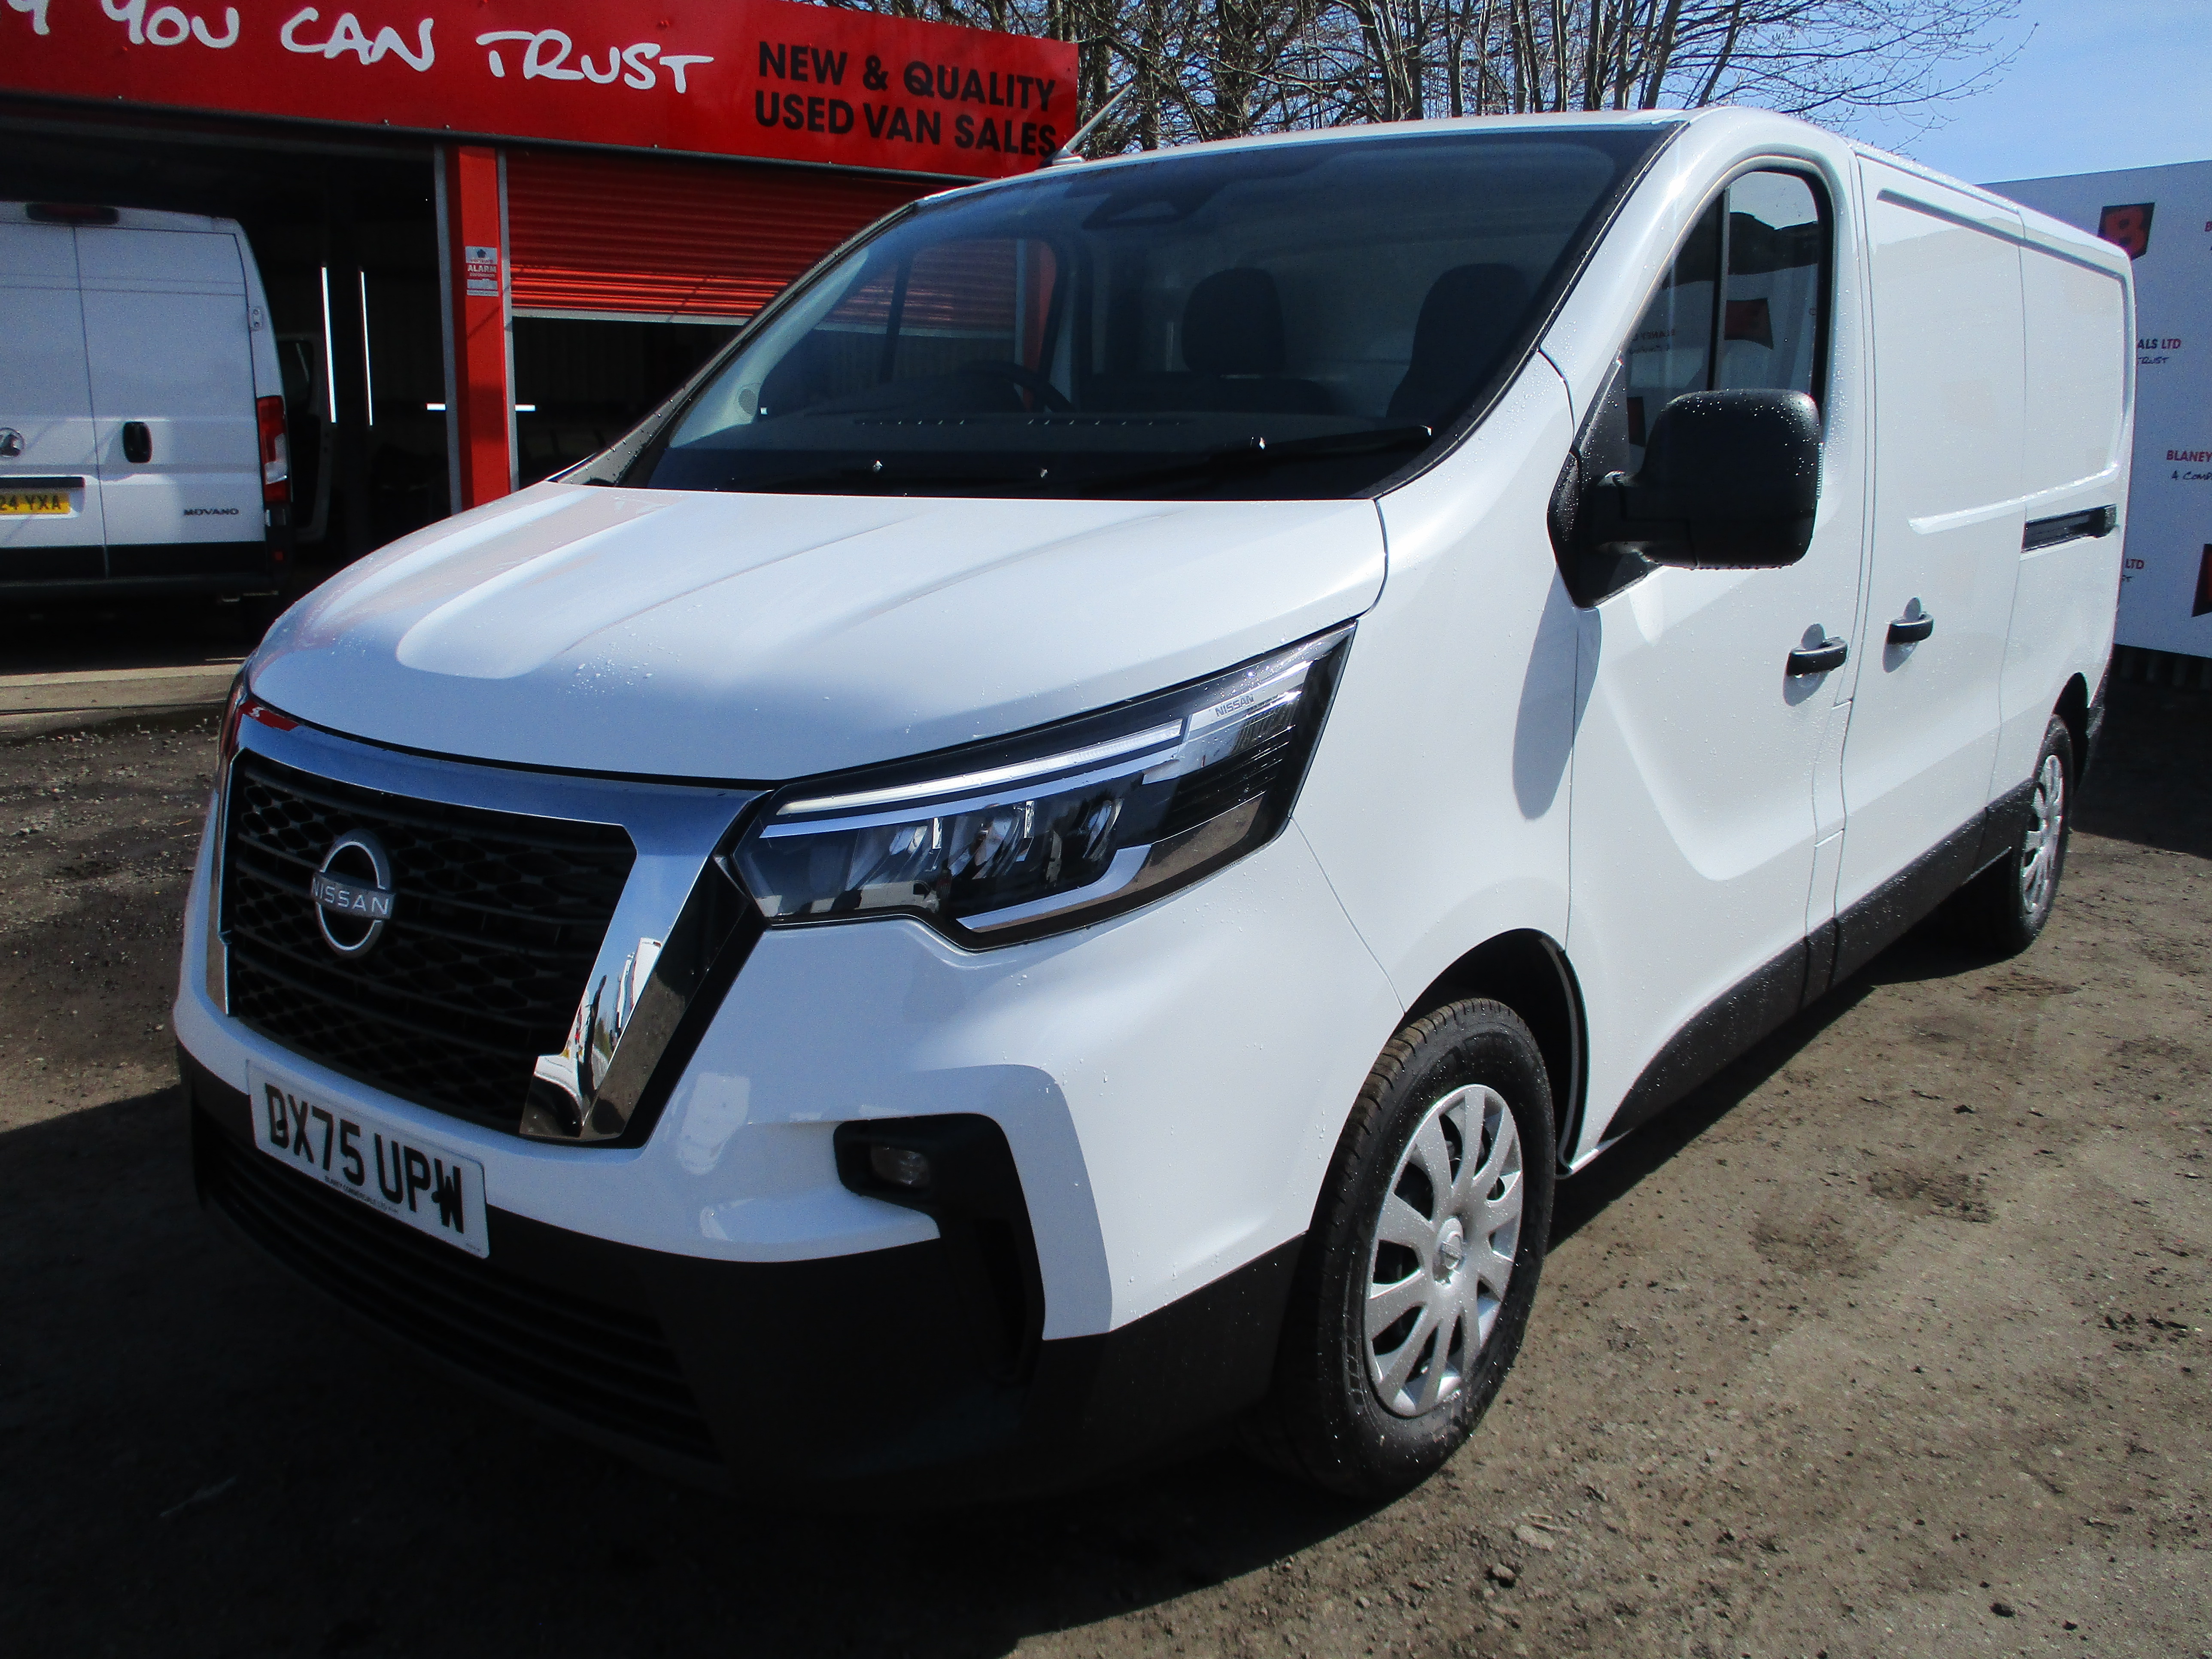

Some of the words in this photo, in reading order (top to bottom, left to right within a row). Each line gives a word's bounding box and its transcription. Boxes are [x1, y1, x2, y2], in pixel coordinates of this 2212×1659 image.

[101, 0, 239, 49] YOU
[280, 6, 434, 72] CAN
[475, 29, 714, 94] TRUST
[759, 41, 848, 86] NEW
[862, 55, 889, 91] &
[903, 61, 1056, 112] QUALITY
[755, 90, 854, 135] USED
[862, 103, 941, 145] VAN
[954, 114, 1057, 158] SALES
[468, 264, 497, 273] ALARM
[2161, 338, 2182, 349] LTD
[2166, 450, 2212, 462] BLANEY
[25, 495, 61, 510] YXA
[184, 507, 240, 516] MOVANO
[2126, 559, 2145, 569] LTD
[1215, 694, 1255, 717] NISSAN
[311, 877, 391, 915] NISSAN
[264, 1082, 365, 1187] DX75
[374, 1133, 465, 1234] UPW
